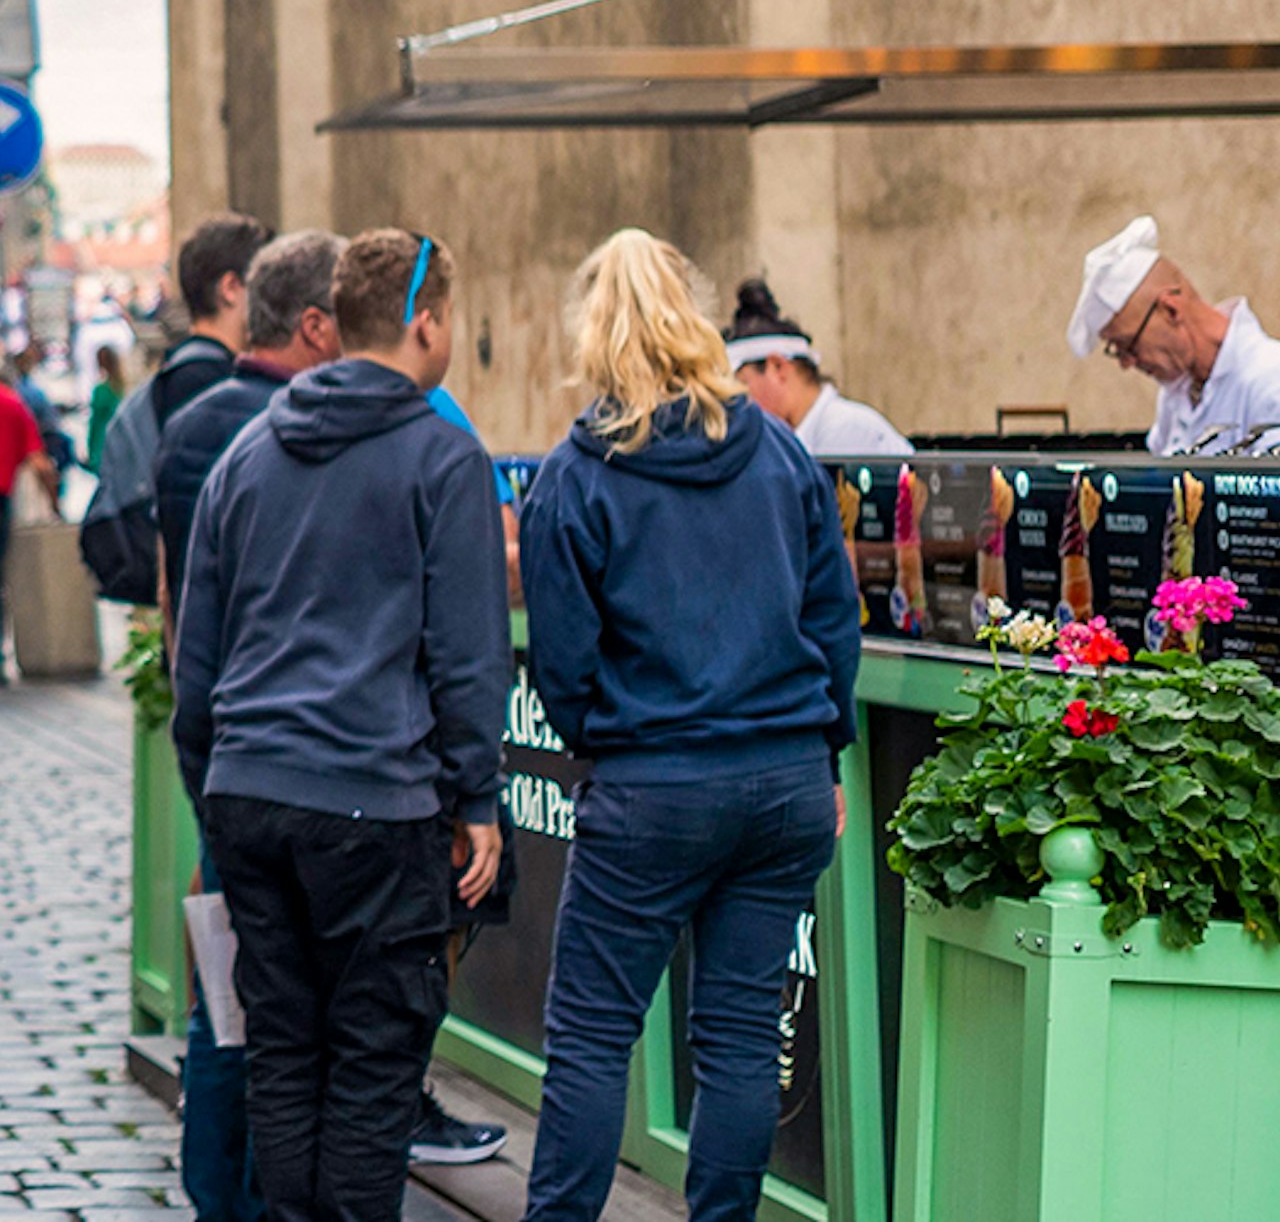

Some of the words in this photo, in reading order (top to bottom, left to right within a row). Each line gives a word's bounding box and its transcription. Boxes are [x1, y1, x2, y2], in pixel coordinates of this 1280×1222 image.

[1214, 475, 1236, 495] HOT
[1237, 475, 1259, 496] DOG
[511, 774, 544, 834] Old
